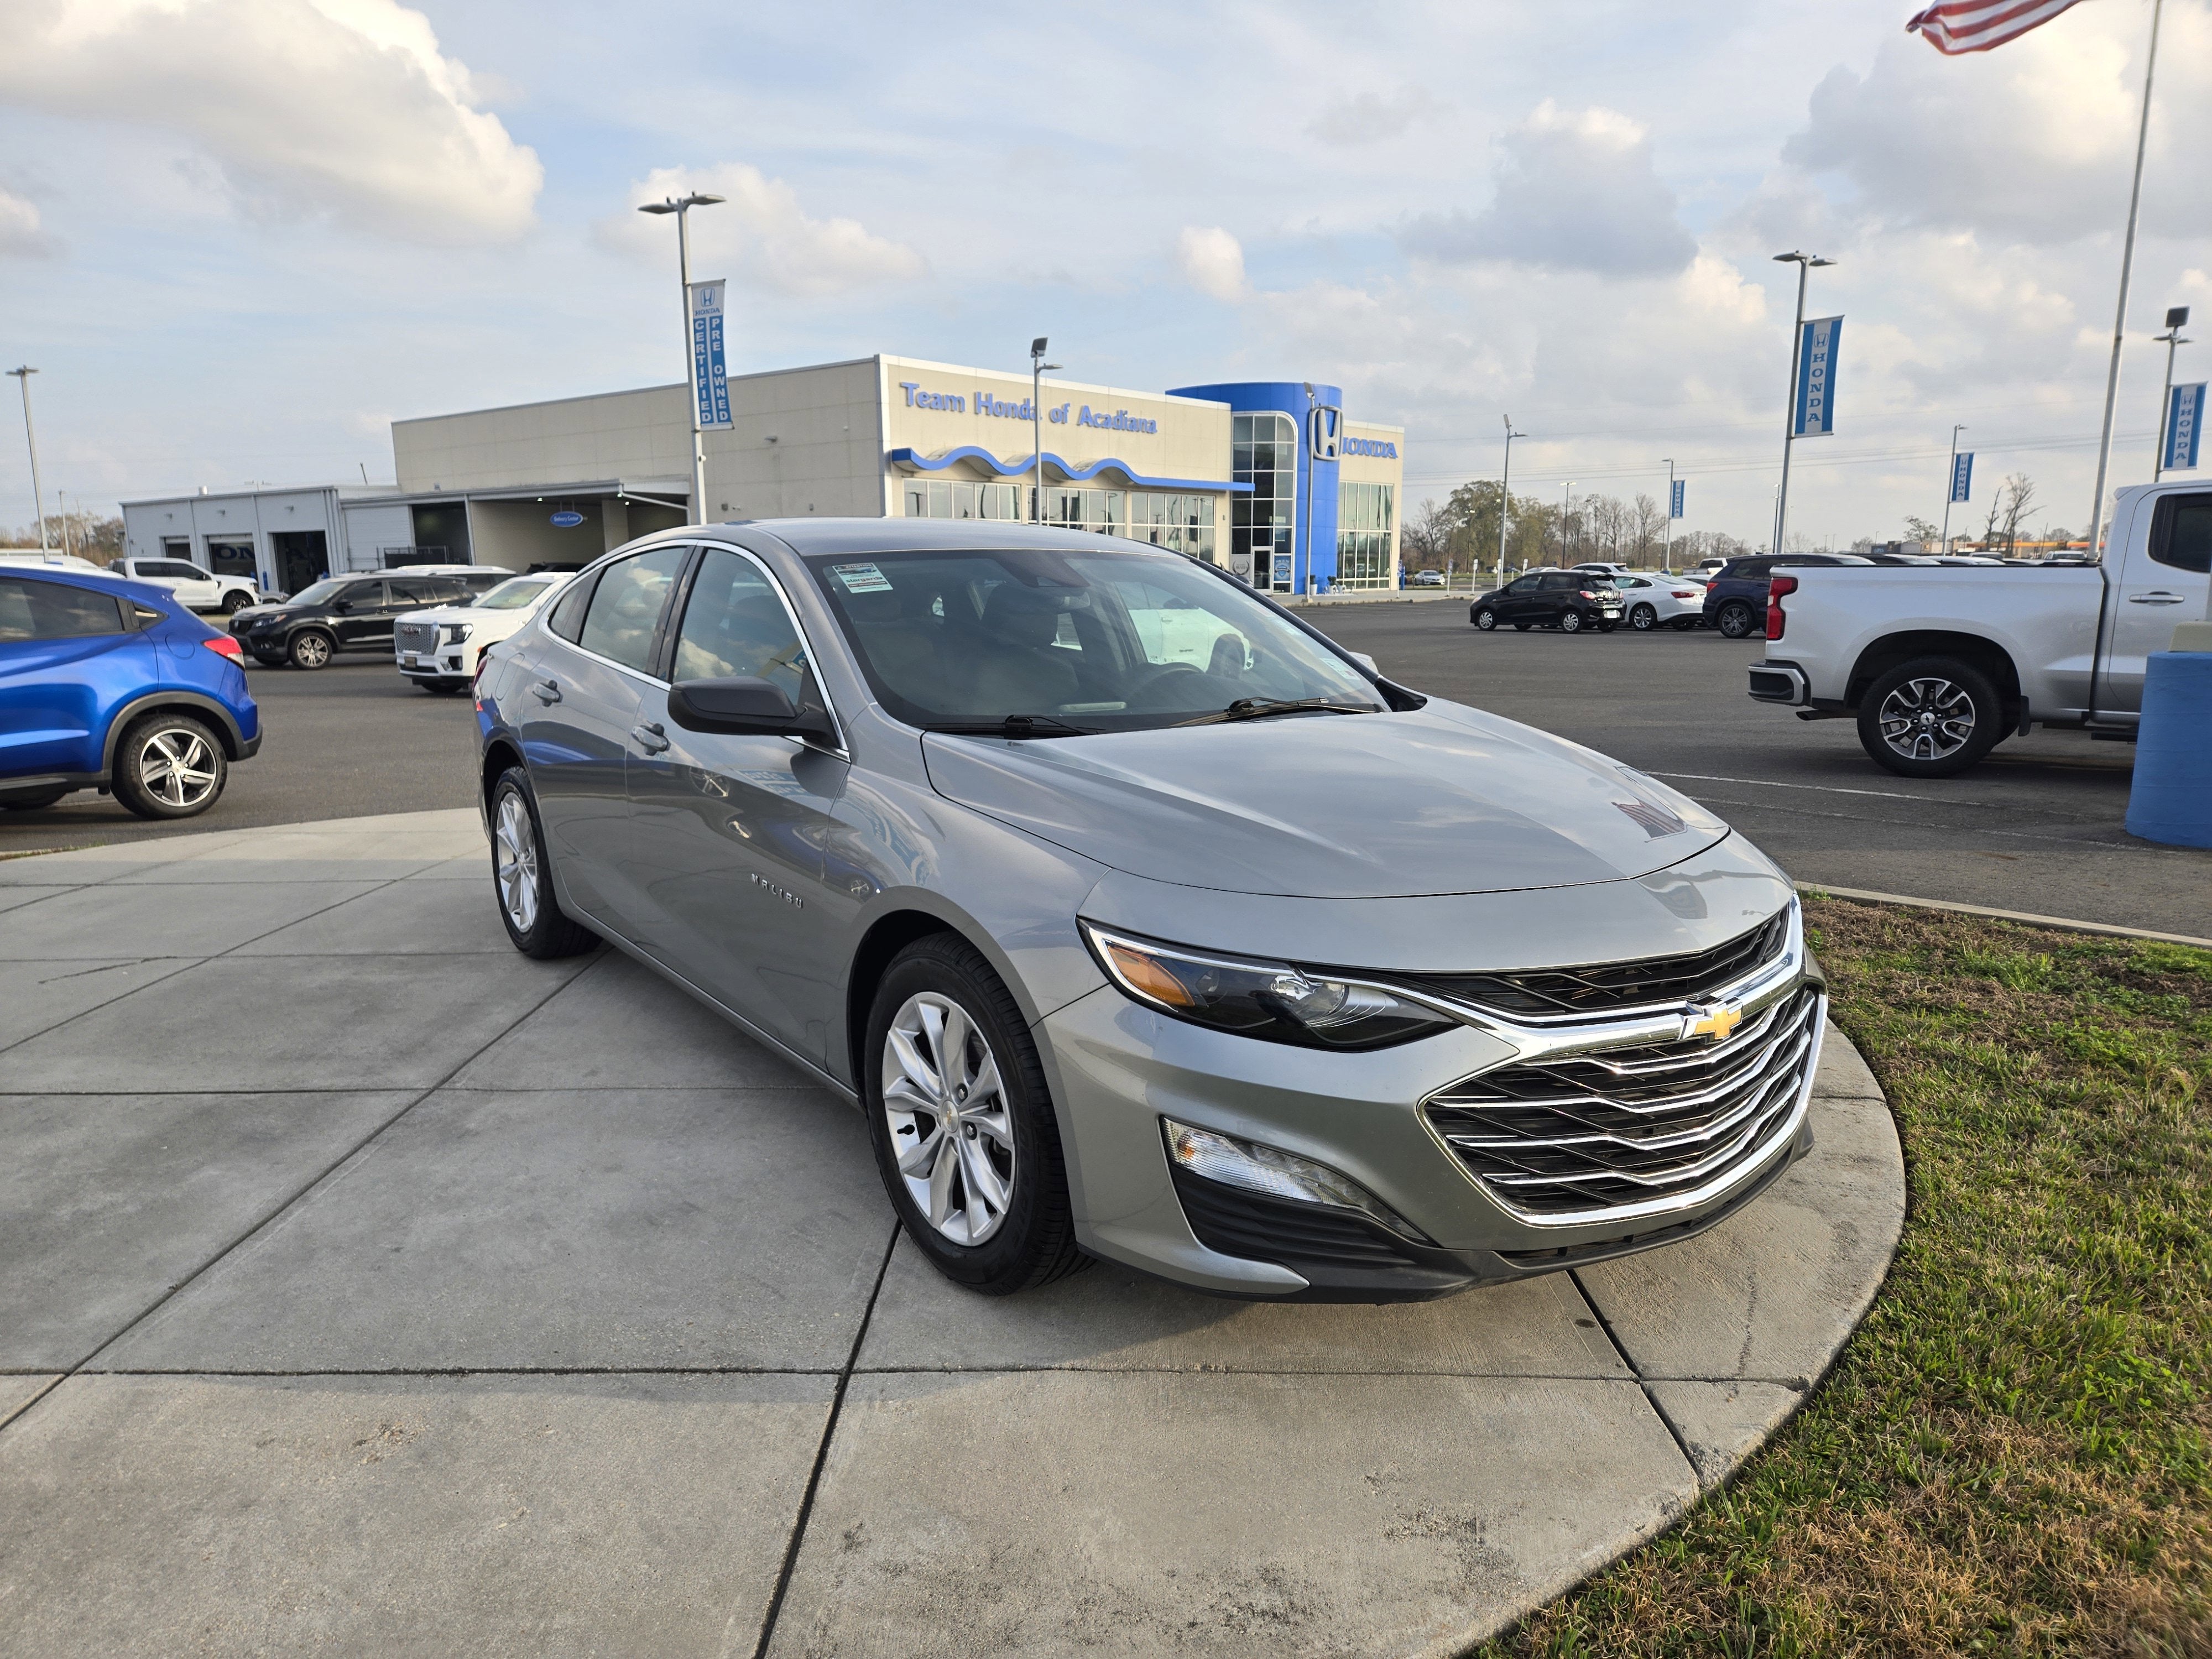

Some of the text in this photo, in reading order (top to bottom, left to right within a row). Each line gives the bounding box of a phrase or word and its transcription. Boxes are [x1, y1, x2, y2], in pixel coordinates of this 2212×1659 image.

[695, 307, 720, 316] HONDA
[695, 320, 711, 422] CERTIFIED
[712, 318, 728, 420] PRE OWNED
[1807, 352, 1826, 422] HONDA
[901, 382, 966, 411] Team
[1050, 403, 1070, 424] of
[1077, 405, 1157, 434] Acadiana
[2175, 408, 2193, 460] HONDA
[752, 873, 804, 909] MALIBU
